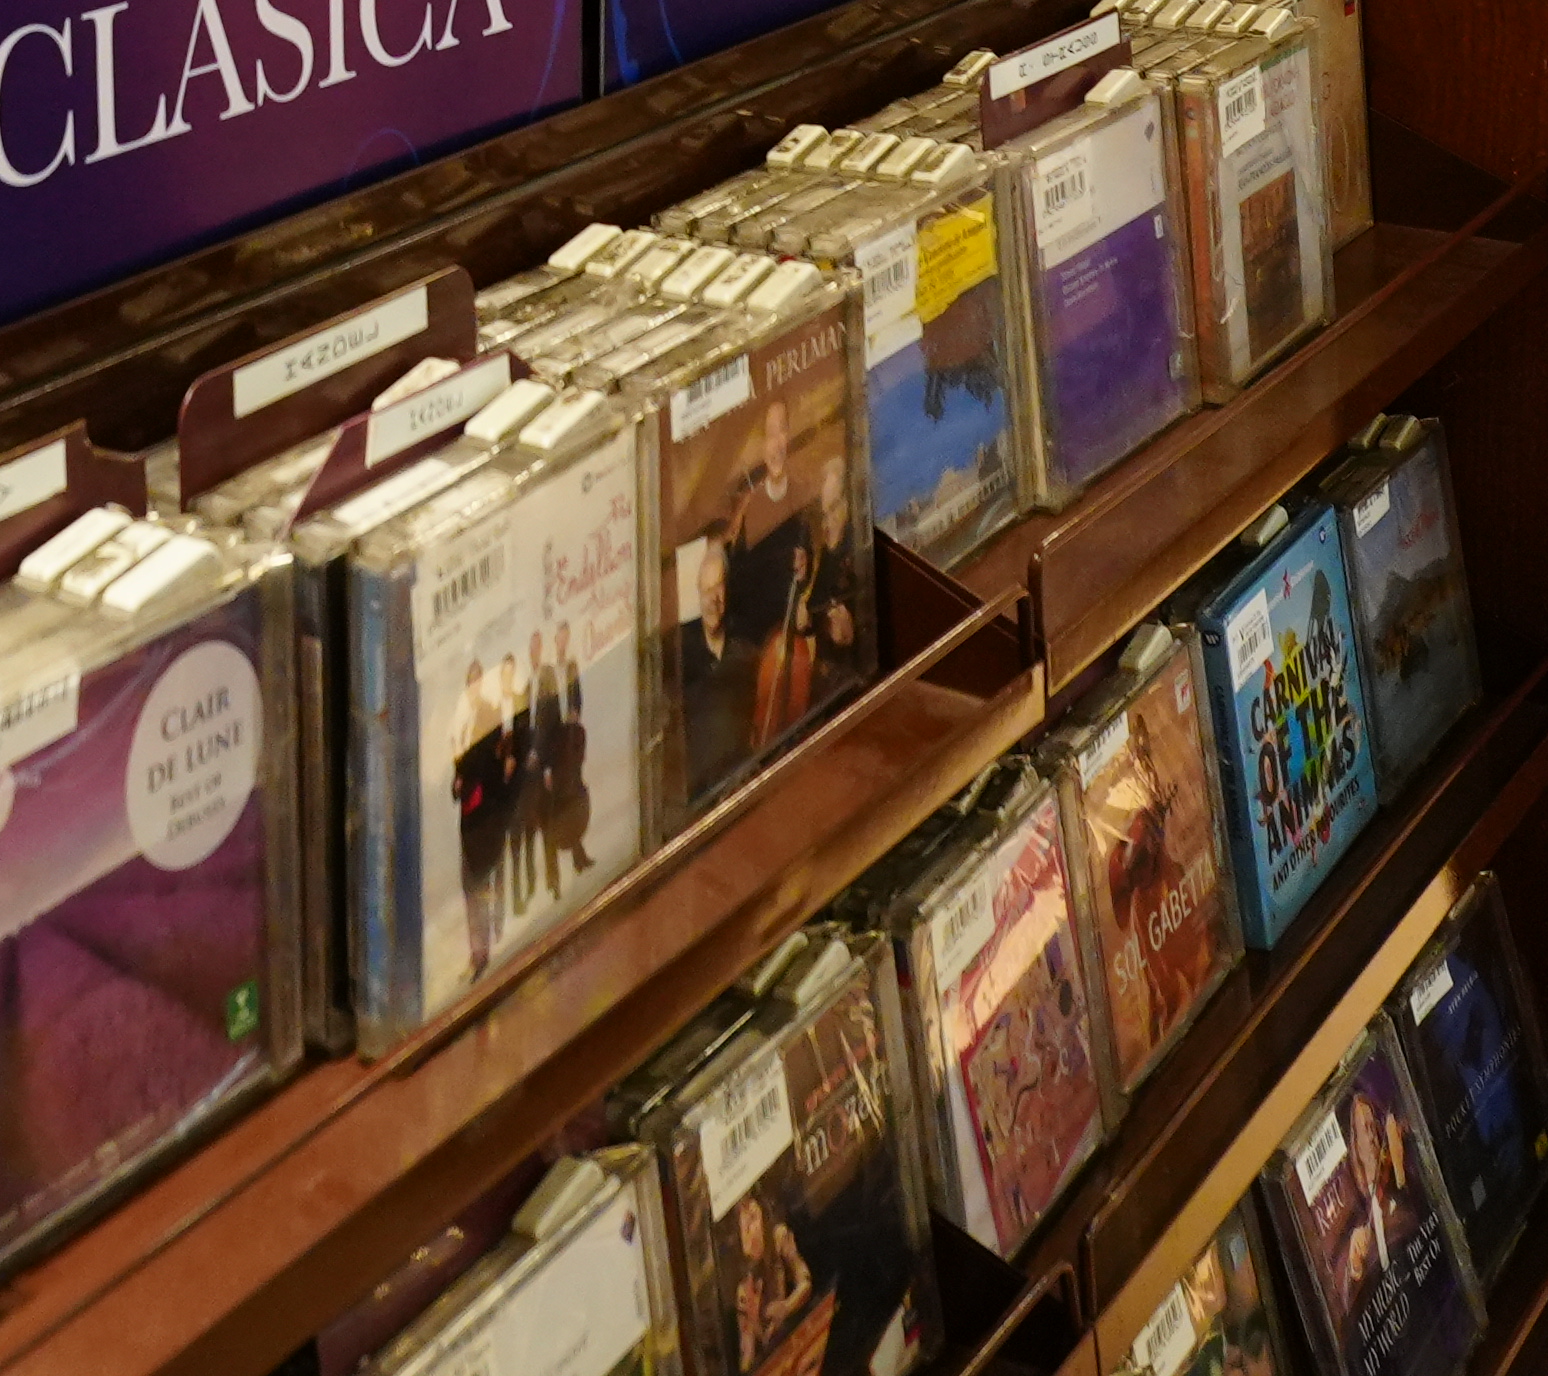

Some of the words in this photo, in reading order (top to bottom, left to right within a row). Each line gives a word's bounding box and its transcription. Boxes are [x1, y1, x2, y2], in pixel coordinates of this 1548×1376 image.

[160, 686, 230, 744] CLAIR
[1250, 616, 1345, 745] CARNIVAL
[145, 752, 177, 796] DE
[185, 717, 245, 775] LUNE
[1273, 868, 1291, 893] AND
[1114, 932, 1148, 997] SOL
[1148, 851, 1217, 952] GABETTA
